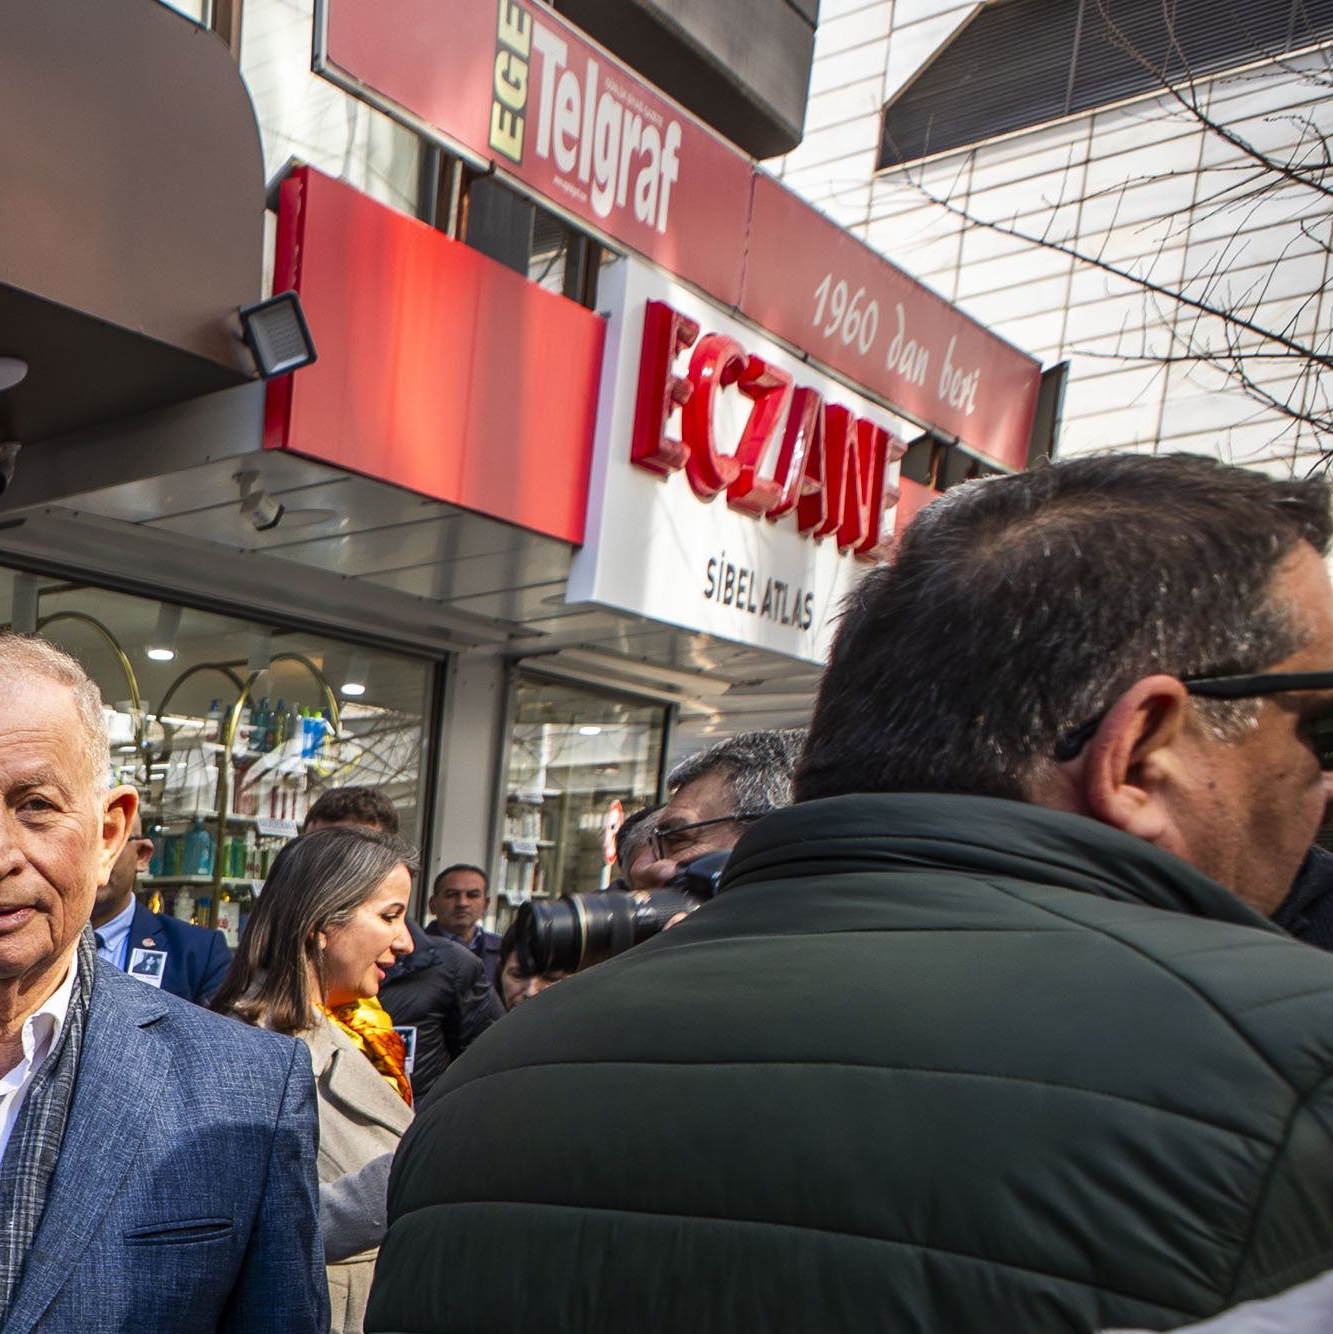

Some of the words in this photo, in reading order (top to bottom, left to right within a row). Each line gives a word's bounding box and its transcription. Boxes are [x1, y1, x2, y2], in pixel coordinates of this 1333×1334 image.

[489, 0, 532, 163] EGE
[533, 21, 682, 235] Telgraf
[812, 273, 879, 356] 1960
[887, 303, 930, 387] dan
[938, 335, 981, 416] beri
[704, 550, 757, 614] SİBEL
[760, 576, 815, 631] ATLAS
